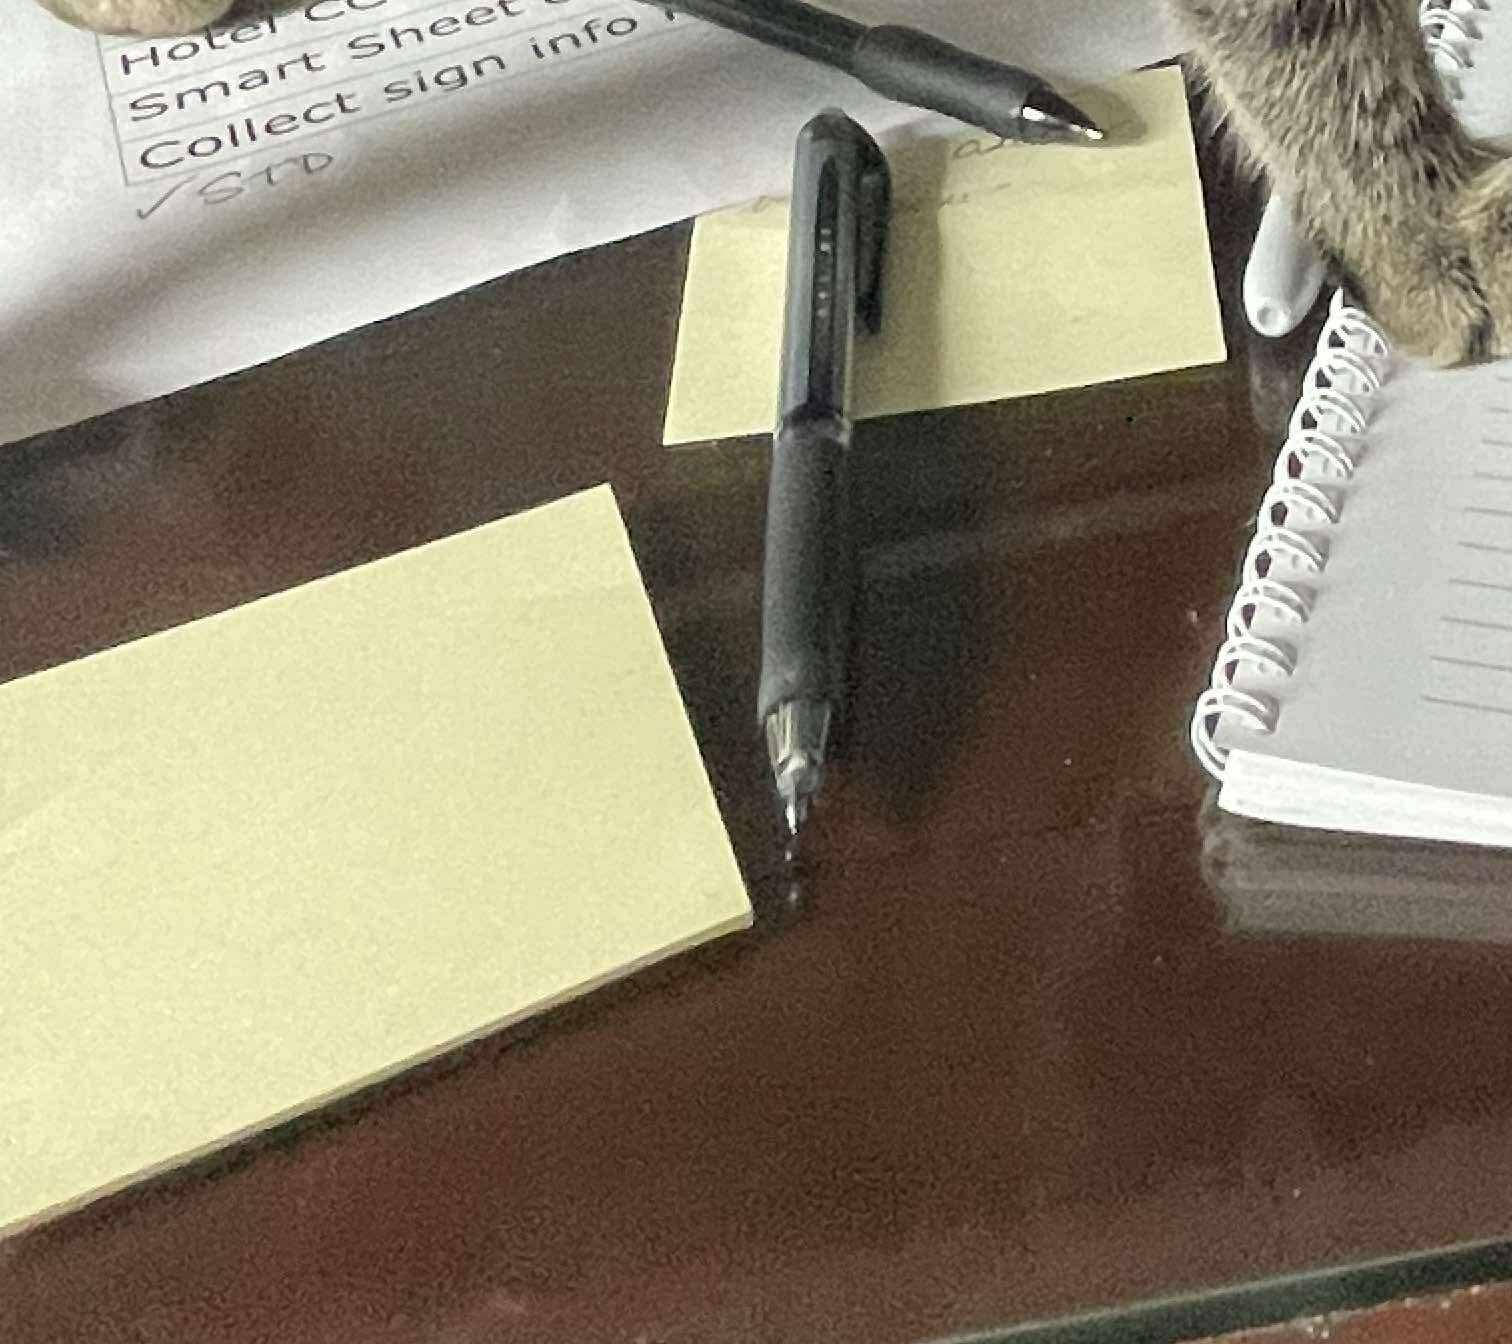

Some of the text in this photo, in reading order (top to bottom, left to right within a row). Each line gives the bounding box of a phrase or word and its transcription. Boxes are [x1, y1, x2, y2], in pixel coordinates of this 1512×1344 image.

[120, 15, 279, 76] Hotel
[128, 51, 327, 122] Smart
[139, 91, 361, 170] Collect
[383, 53, 507, 103] sign
[528, 15, 638, 60] info
